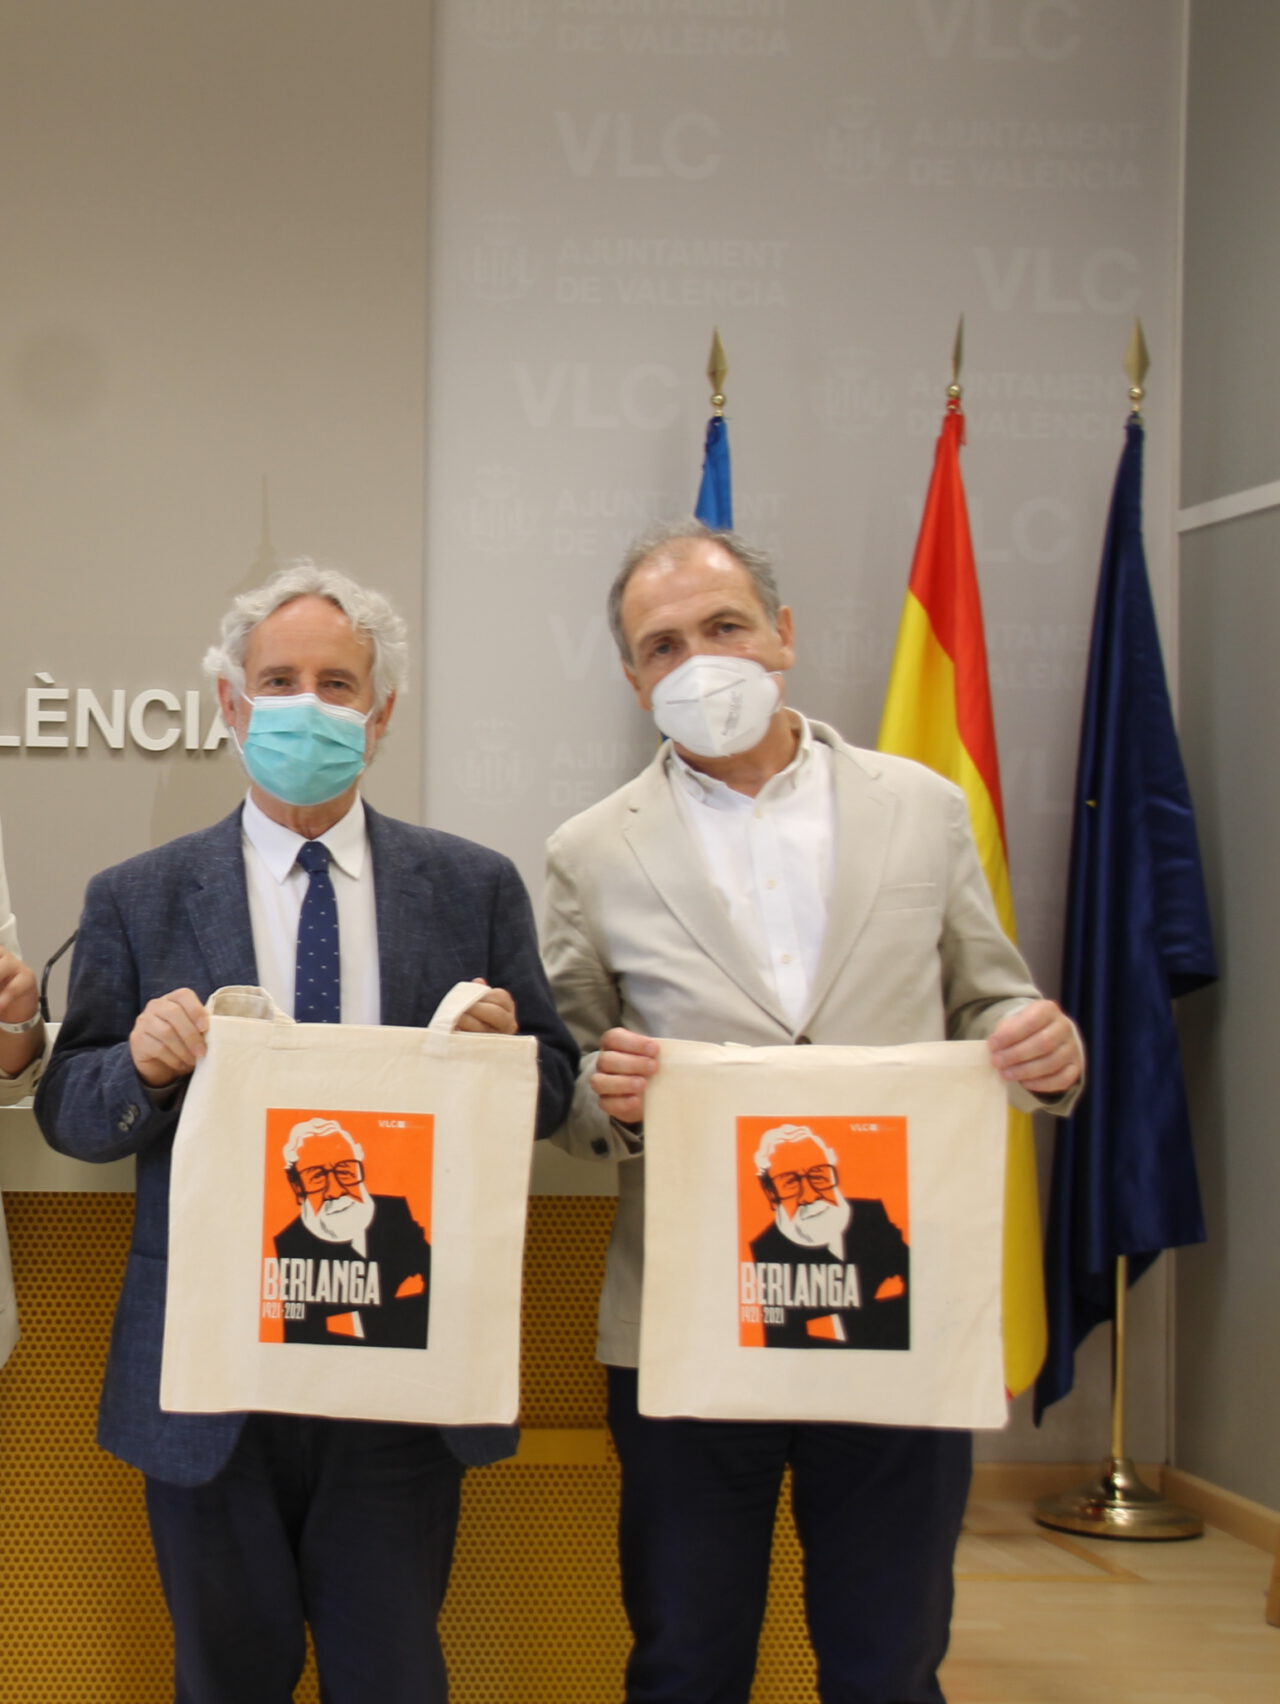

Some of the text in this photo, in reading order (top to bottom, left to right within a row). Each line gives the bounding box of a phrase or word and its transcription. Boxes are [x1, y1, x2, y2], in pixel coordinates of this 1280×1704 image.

[553, 110, 721, 181] VLC
[973, 246, 1143, 316] VLC
[511, 361, 681, 431] VLC
[263, 1258, 381, 1305] BERLANGA
[741, 1262, 860, 1307] BERLANGA
